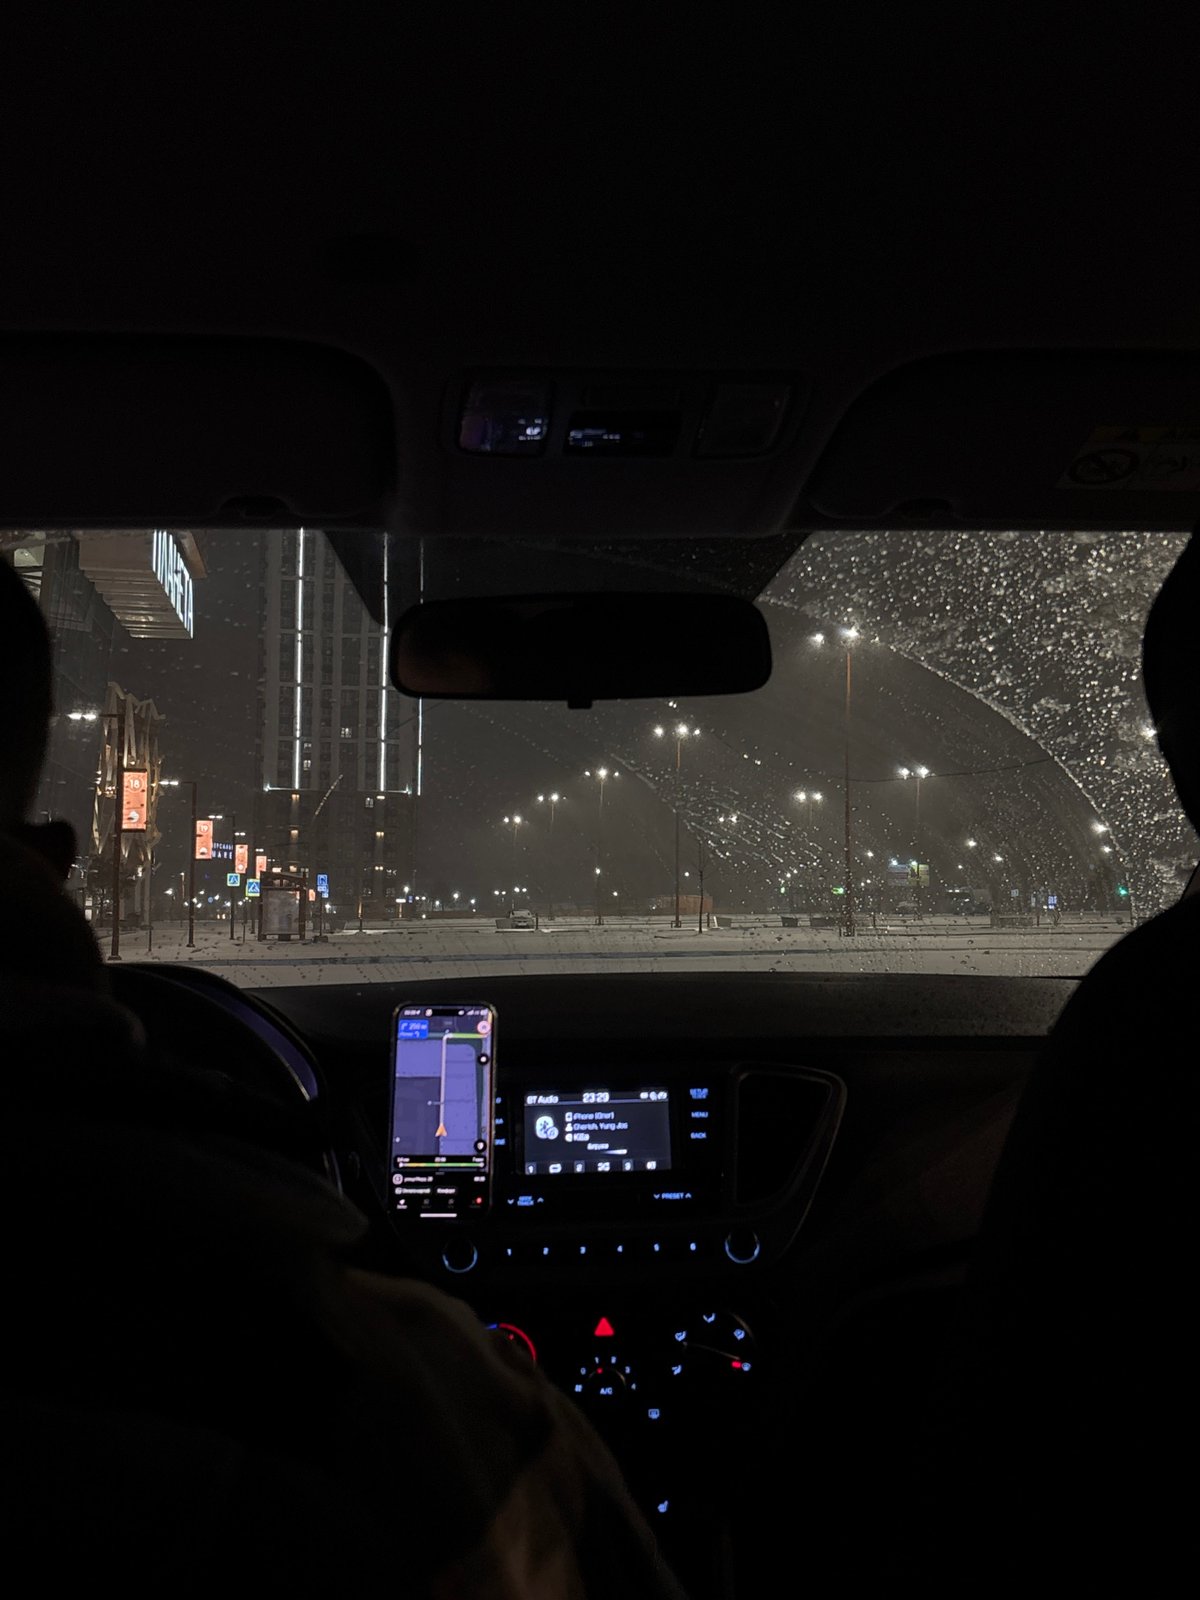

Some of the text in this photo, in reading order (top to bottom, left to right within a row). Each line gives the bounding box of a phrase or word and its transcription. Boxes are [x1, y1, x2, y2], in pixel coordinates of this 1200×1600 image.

[130, 779, 140, 789] 18
[538, 1095, 559, 1104] Audio
[661, 1192, 684, 1200] PRESET
[600, 1387, 613, 1395] A/C
